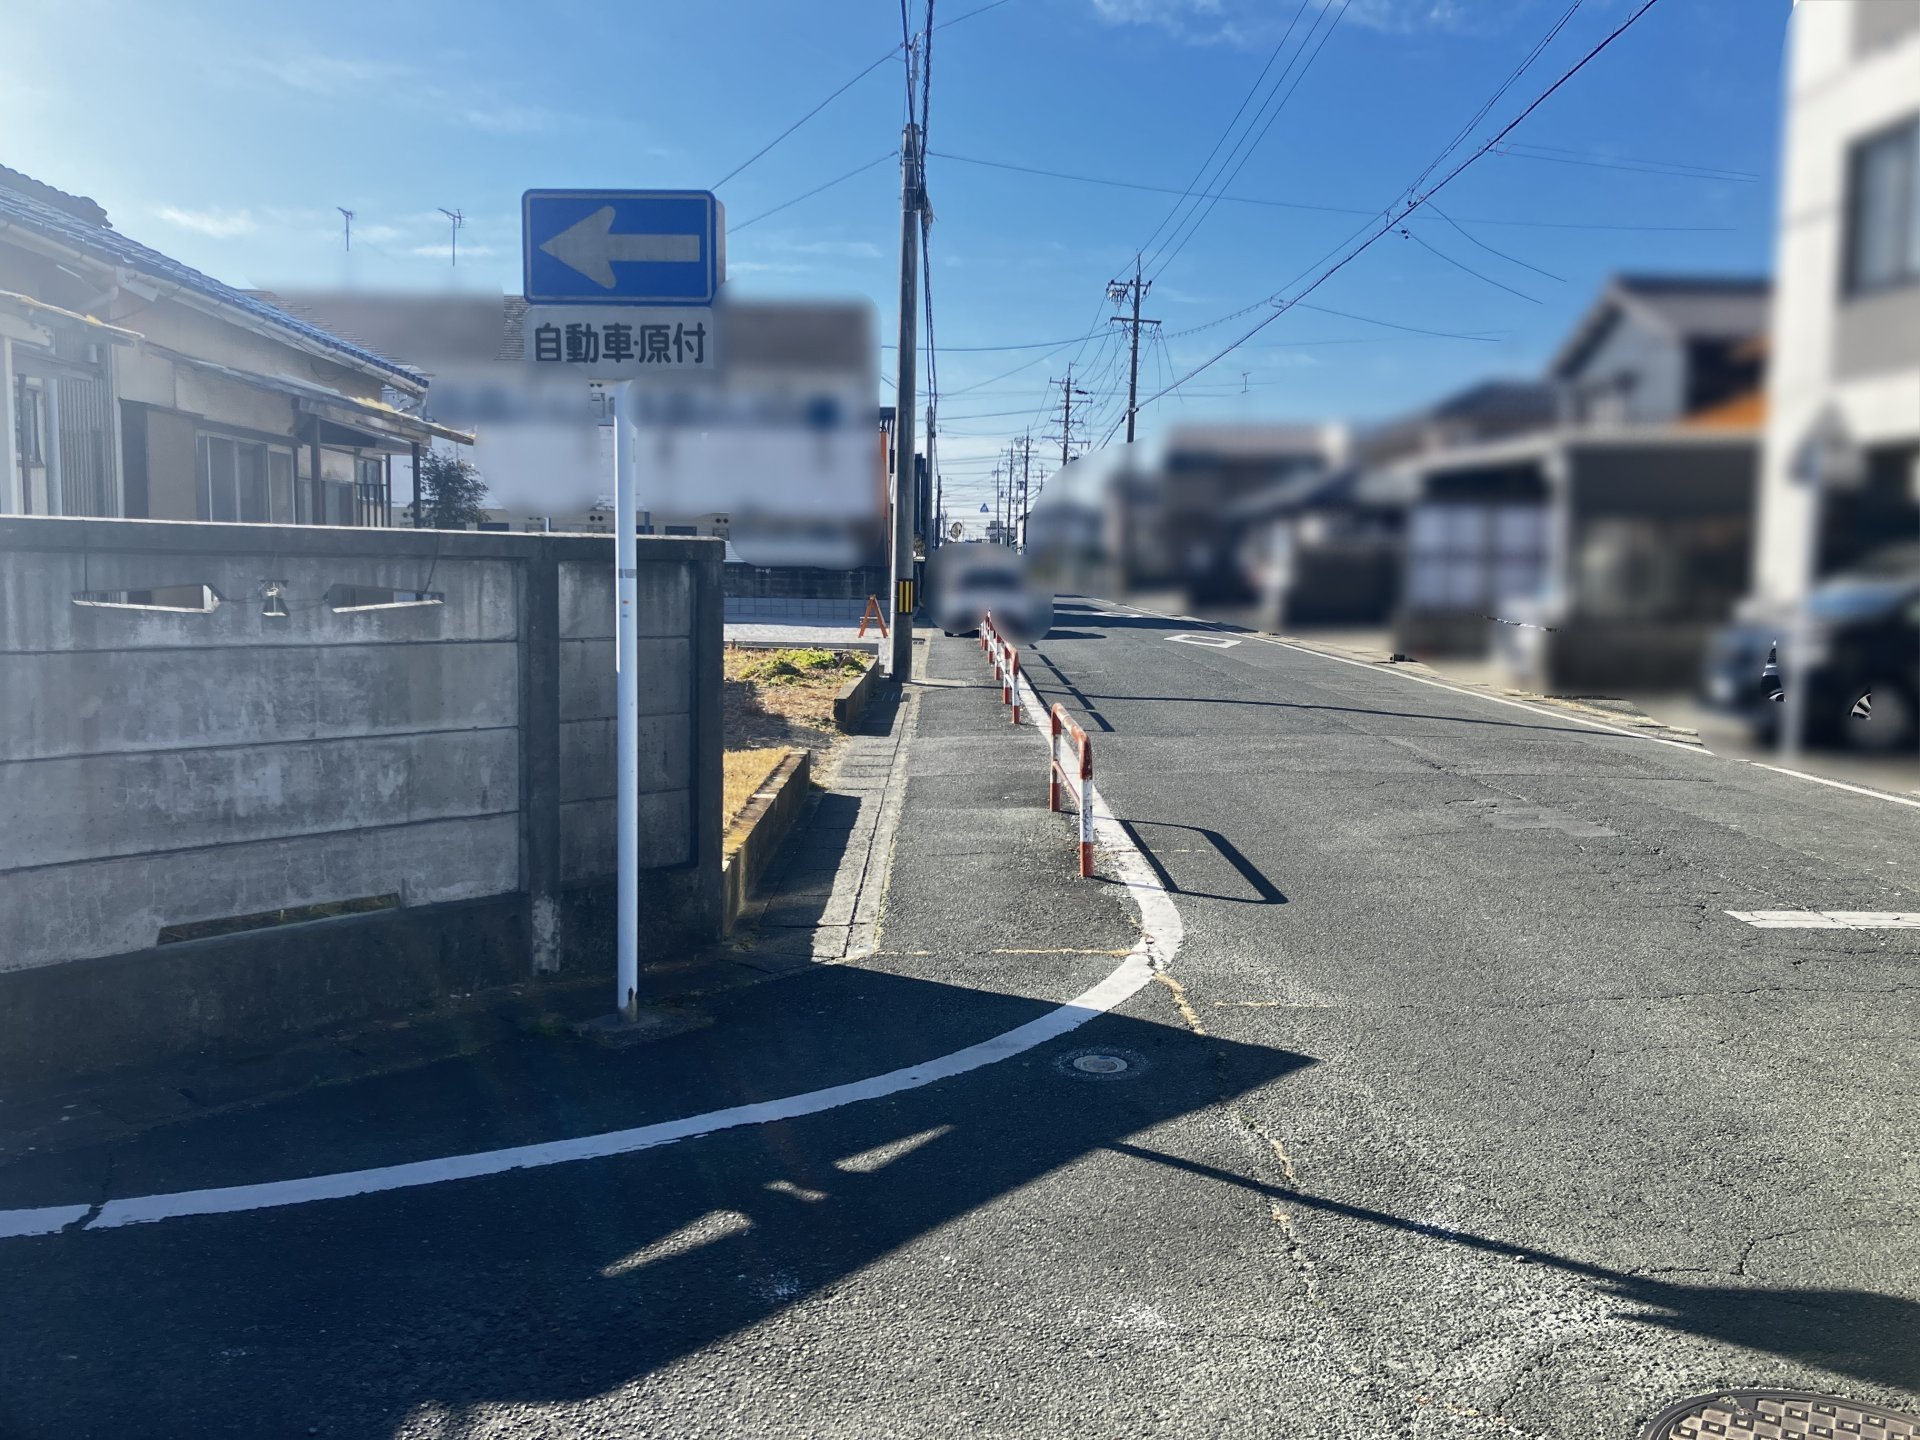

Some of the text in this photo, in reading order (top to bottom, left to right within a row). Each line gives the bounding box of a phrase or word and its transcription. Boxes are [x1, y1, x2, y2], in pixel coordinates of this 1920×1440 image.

[535, 322, 706, 363] 自動車・原付
